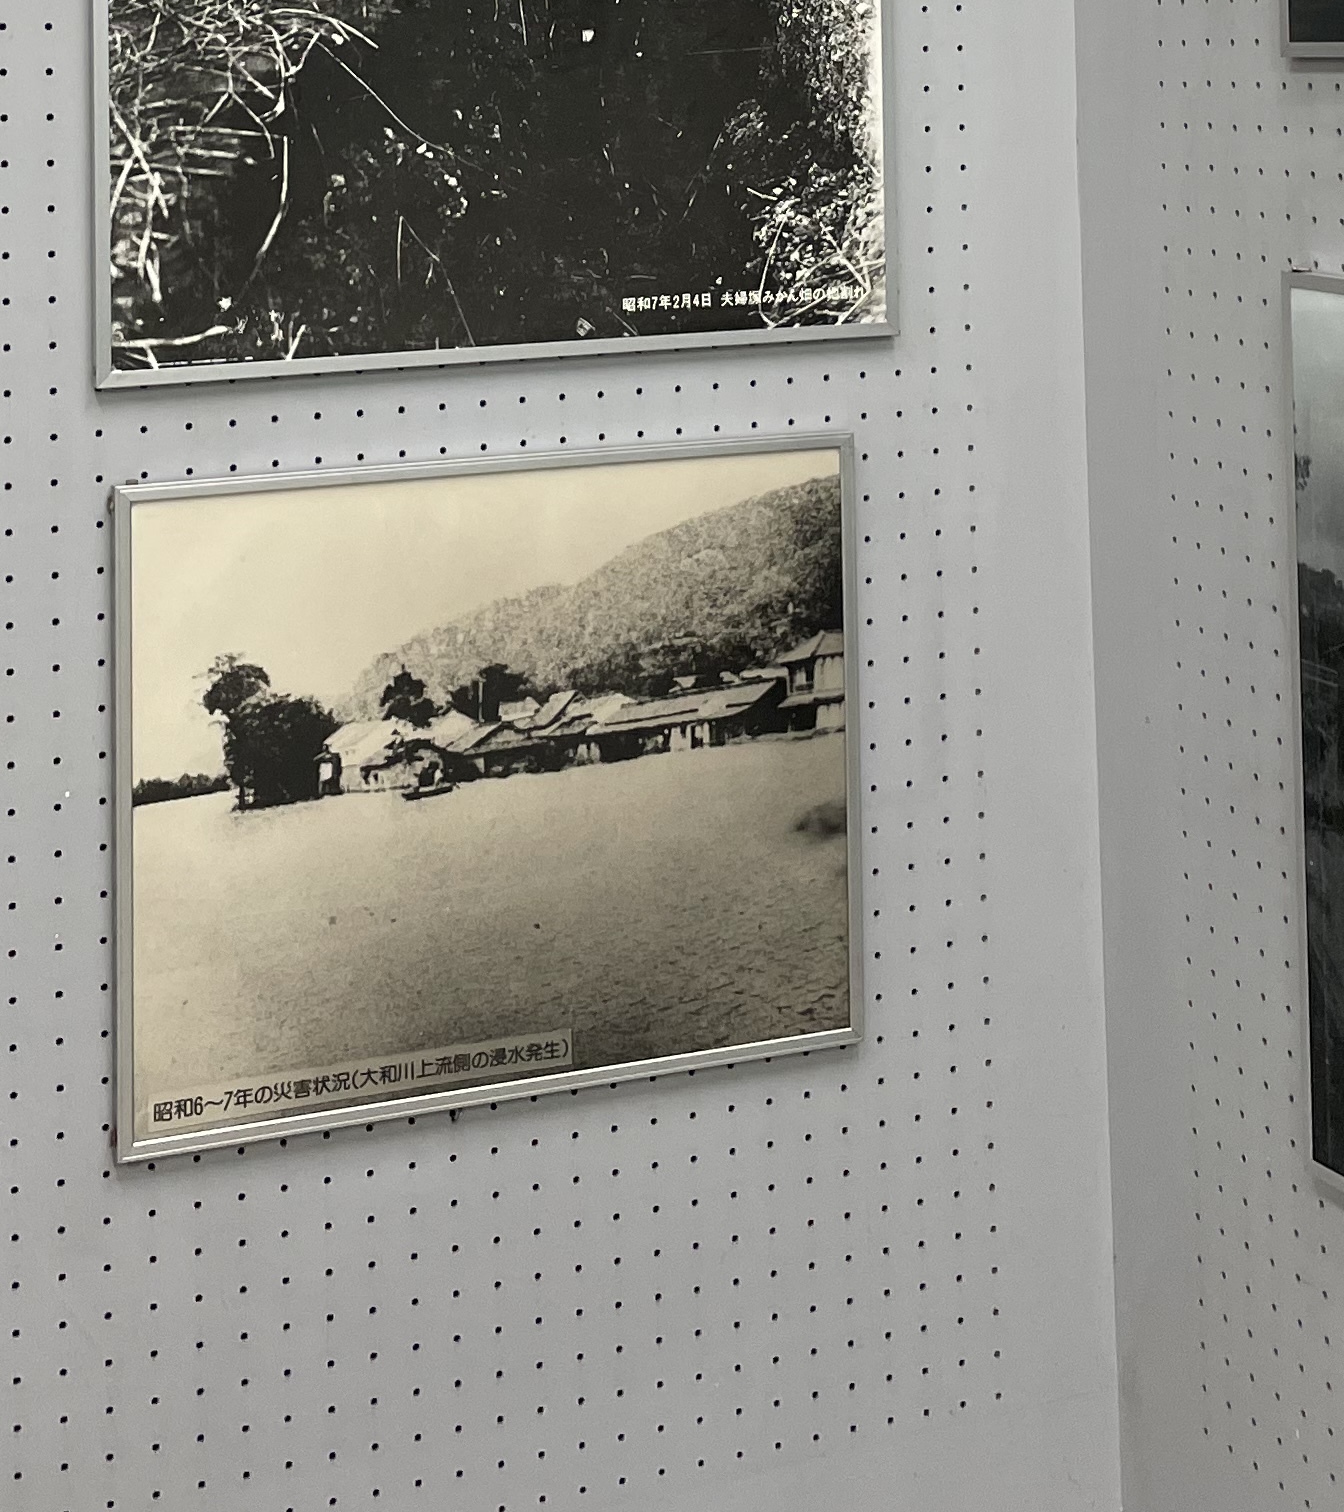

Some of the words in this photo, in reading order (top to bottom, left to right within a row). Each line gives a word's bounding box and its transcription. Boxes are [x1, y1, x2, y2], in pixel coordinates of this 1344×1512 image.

[622, 292, 712, 312] 昭和7年2月4日
